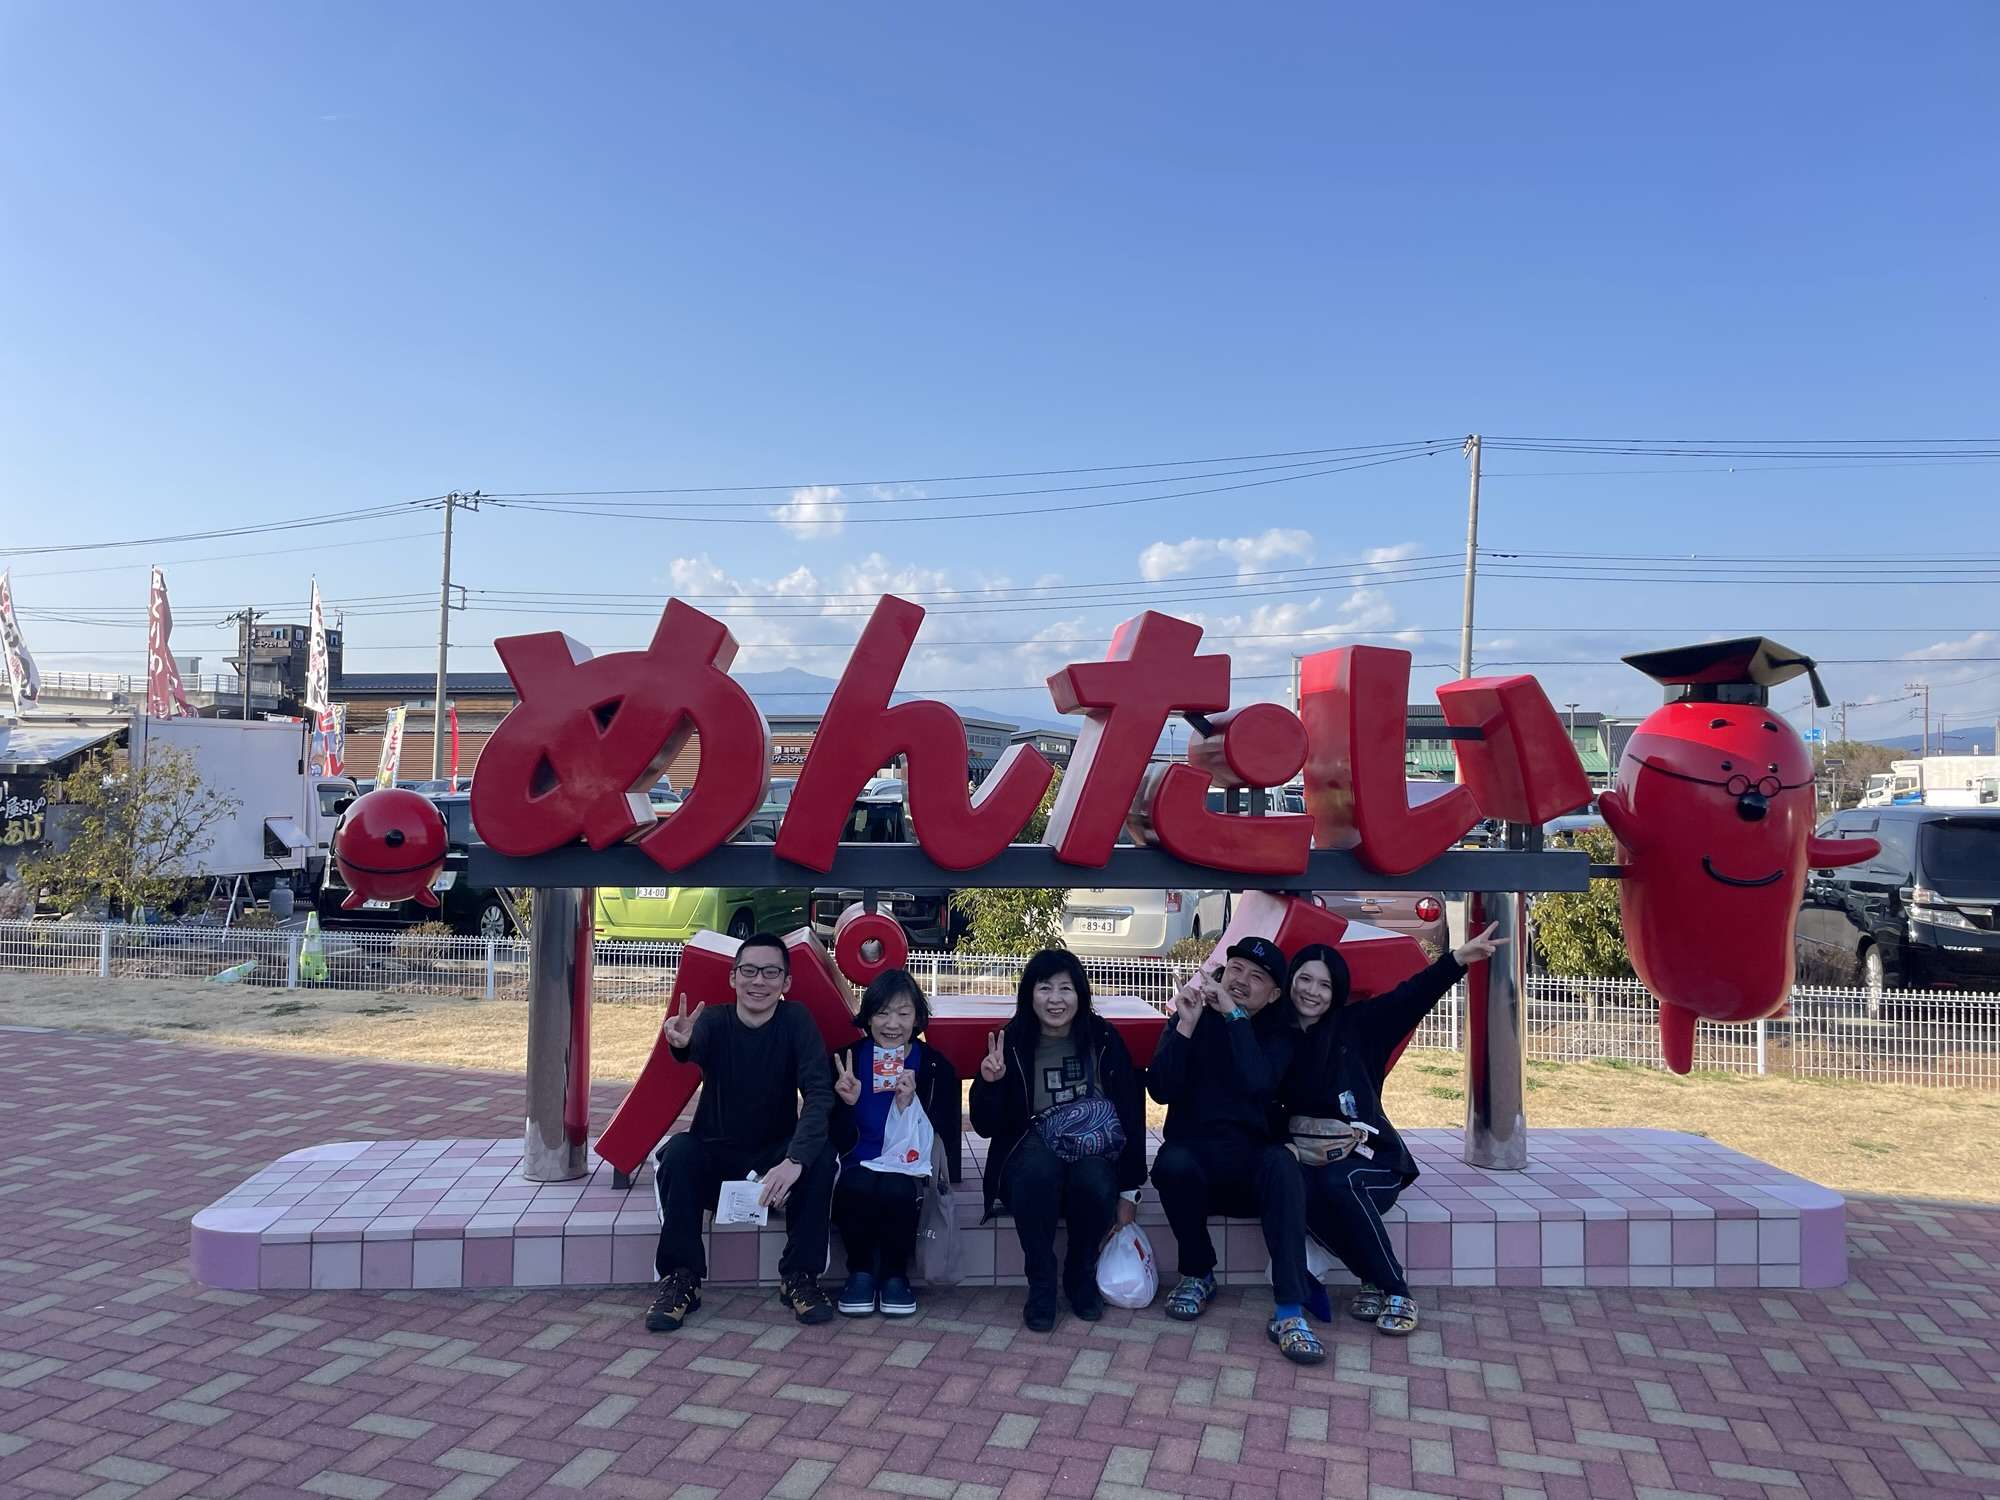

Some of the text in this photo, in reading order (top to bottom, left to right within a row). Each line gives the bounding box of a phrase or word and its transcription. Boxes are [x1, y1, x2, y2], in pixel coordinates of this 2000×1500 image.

[0, 796, 46, 819] 屋さんの
[471, 594, 1592, 875] めんたい
